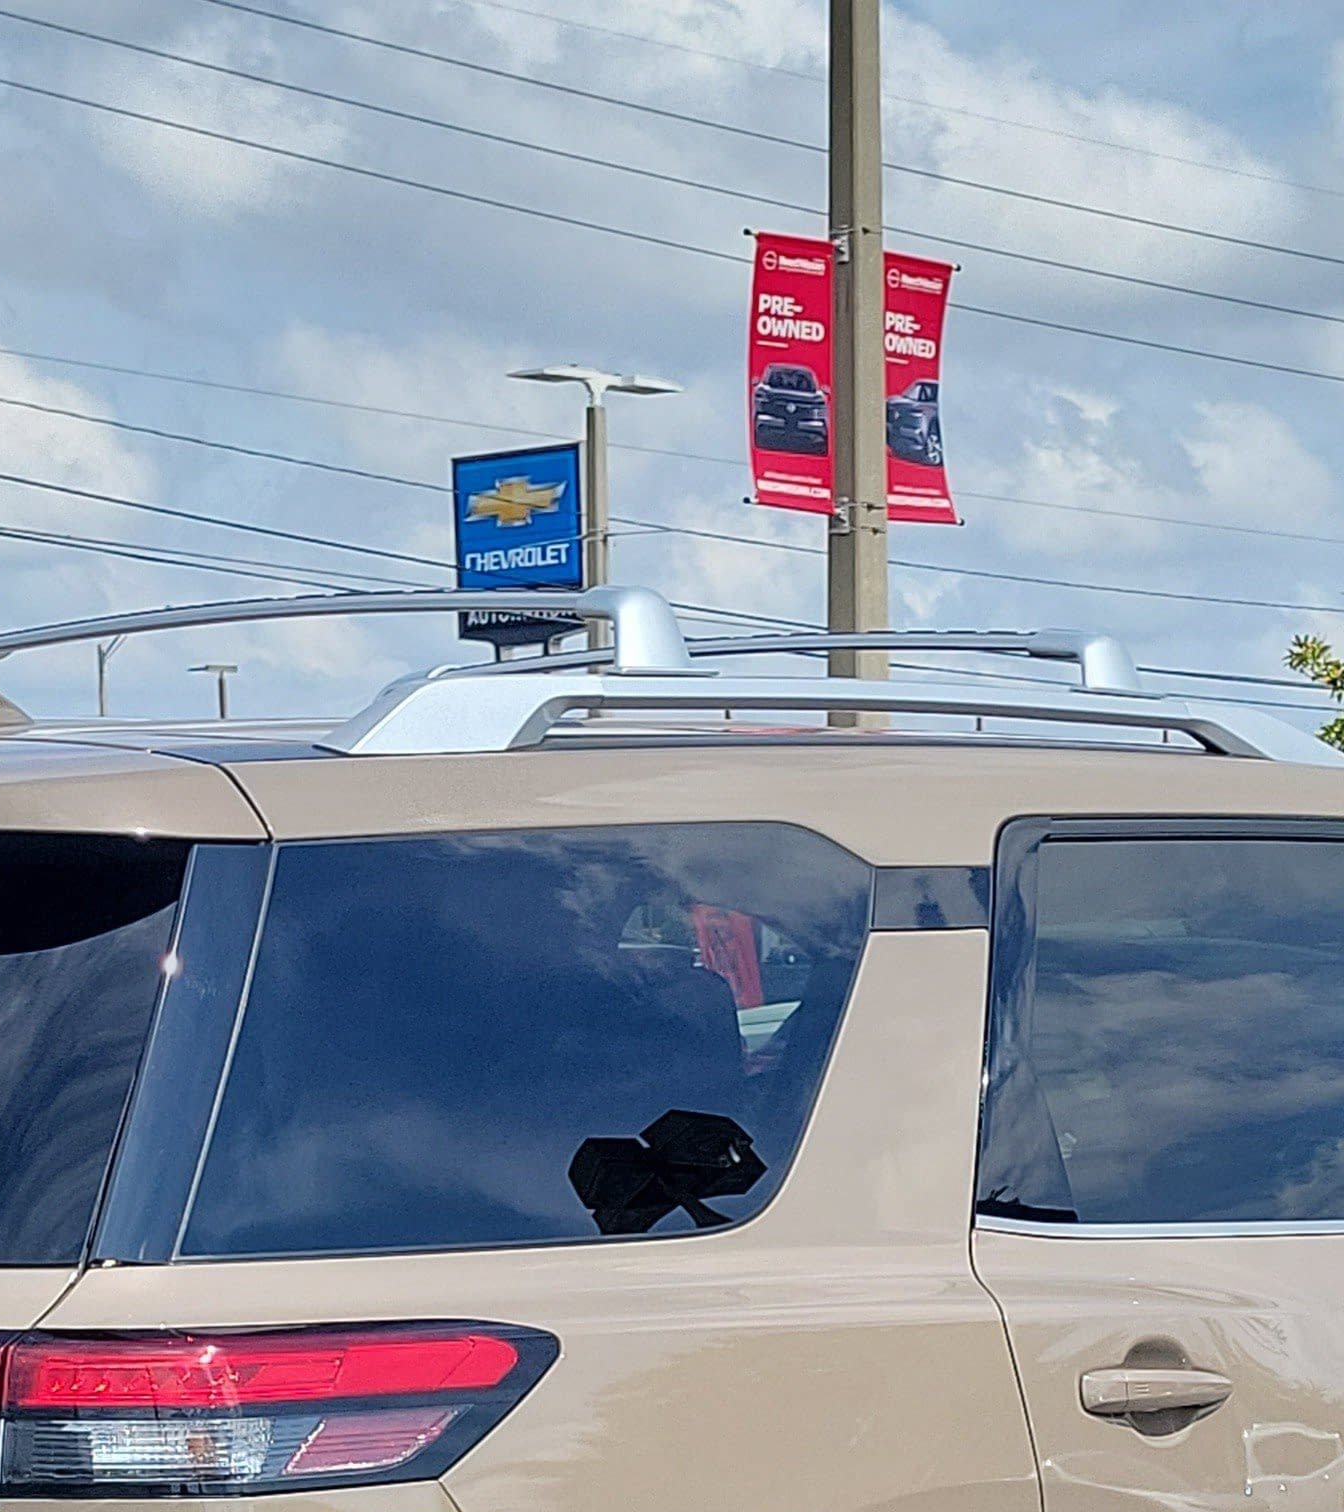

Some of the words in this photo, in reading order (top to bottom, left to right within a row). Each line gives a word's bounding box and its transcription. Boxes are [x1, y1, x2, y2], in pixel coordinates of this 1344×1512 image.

[758, 294, 804, 317] PRE-
[756, 316, 825, 342] OWNED
[884, 311, 922, 335] PRE-
[884, 332, 937, 359] OWNED
[465, 543, 570, 572] CHEVROLET
